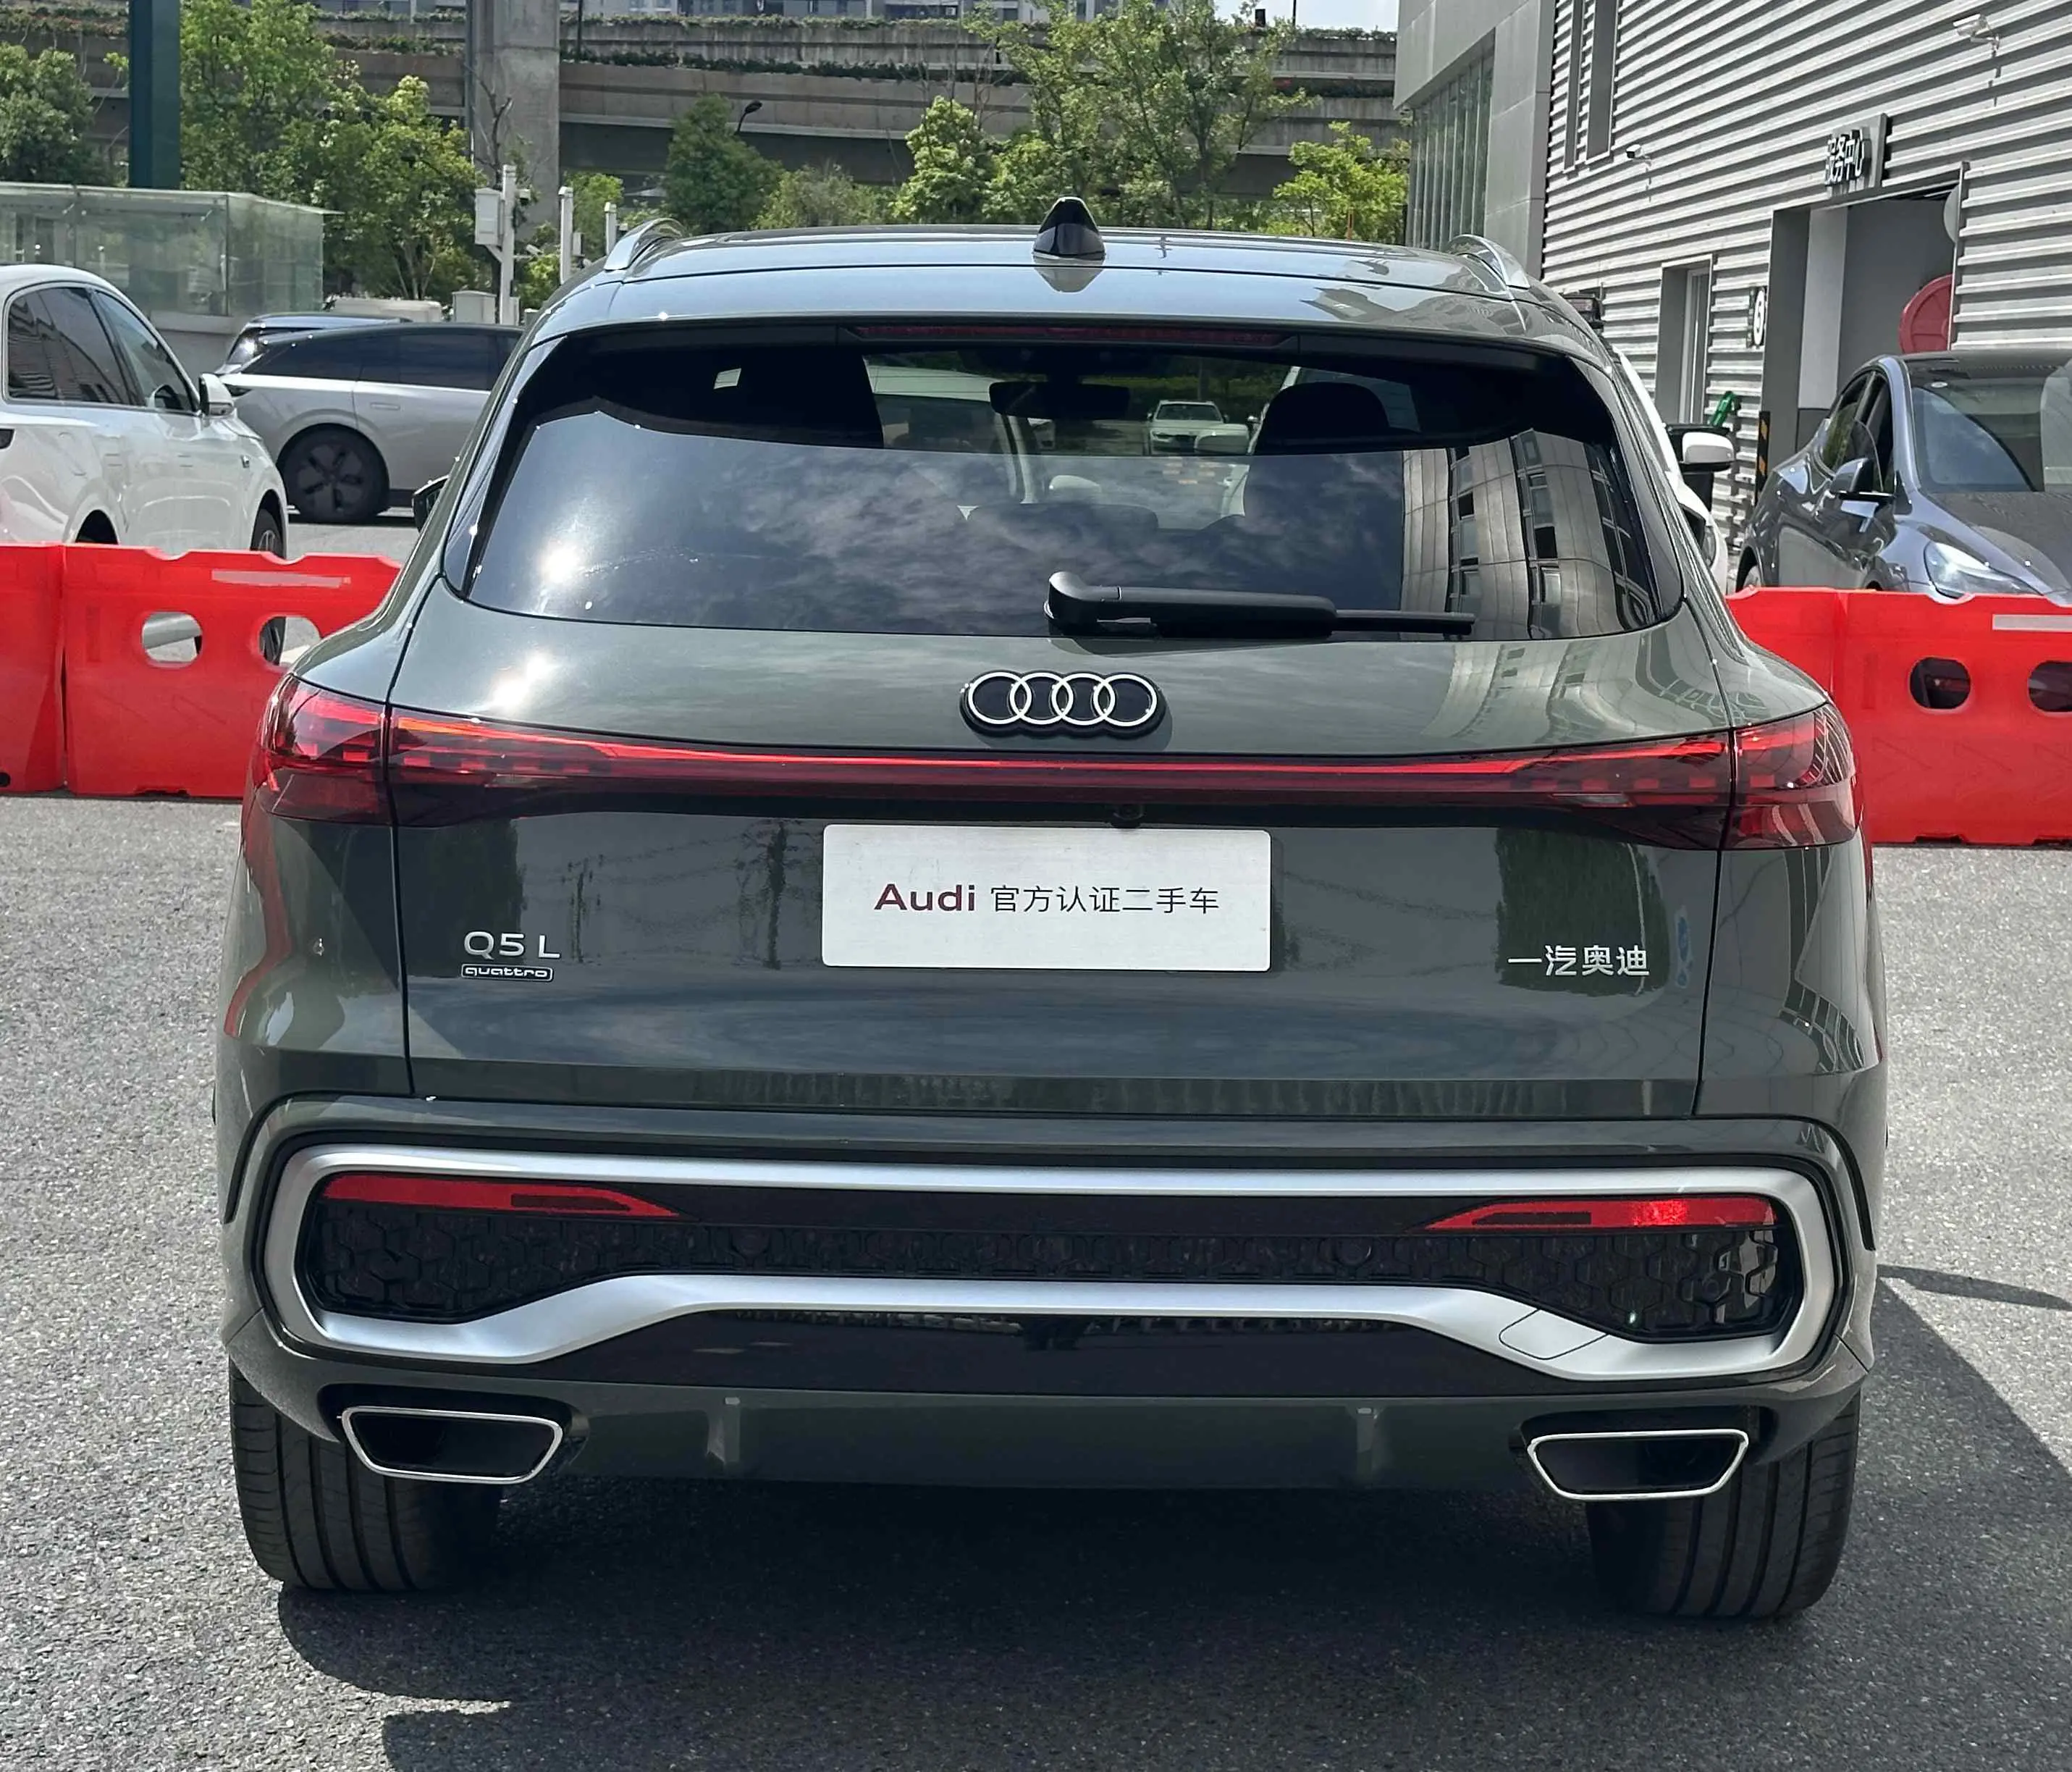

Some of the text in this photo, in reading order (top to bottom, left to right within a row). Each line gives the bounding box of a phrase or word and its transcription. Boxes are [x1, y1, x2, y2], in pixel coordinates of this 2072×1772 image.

[874, 883, 1220, 915] Audi 官方认证二手车
[465, 967, 548, 978] quattro
[1507, 944, 1650, 976] 一汽奥迪
